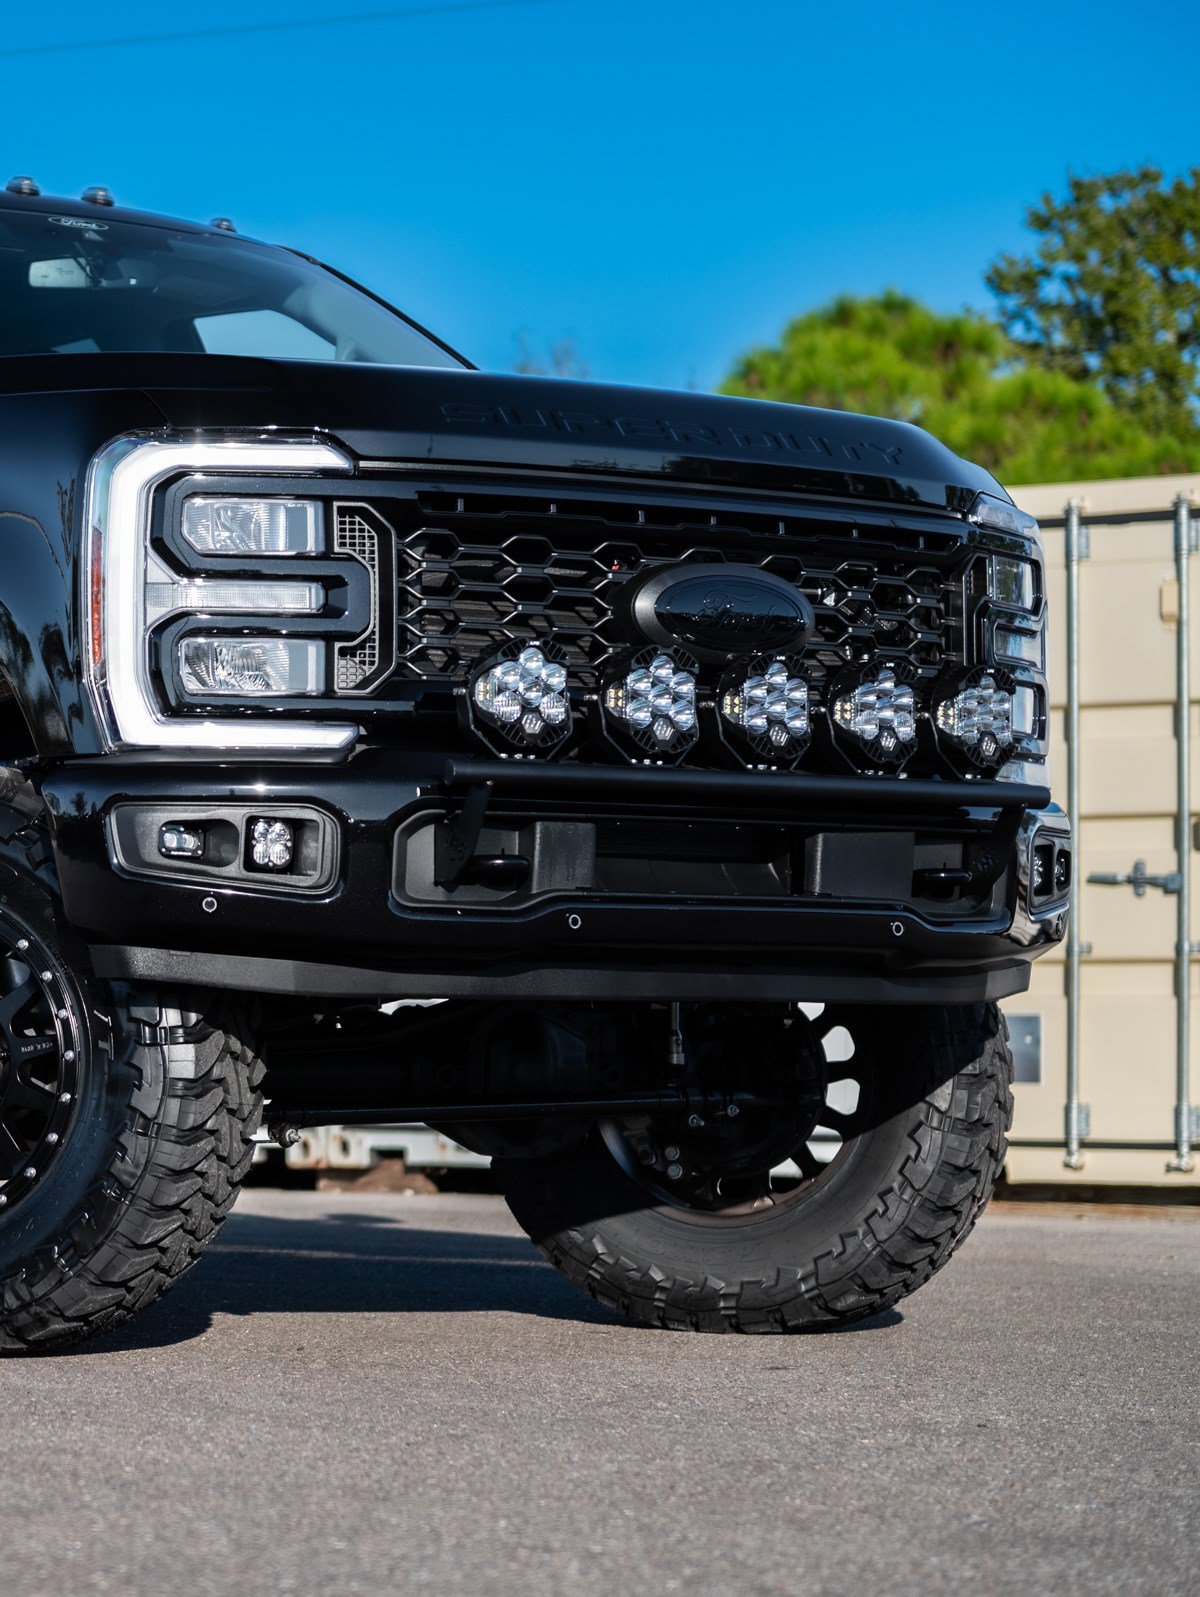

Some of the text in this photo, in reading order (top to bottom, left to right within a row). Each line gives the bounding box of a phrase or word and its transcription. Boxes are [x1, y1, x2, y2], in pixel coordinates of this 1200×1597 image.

[60, 217, 99, 229] Ford
[440, 402, 903, 465] SUPER DUTY
[697, 590, 776, 632] Ford
